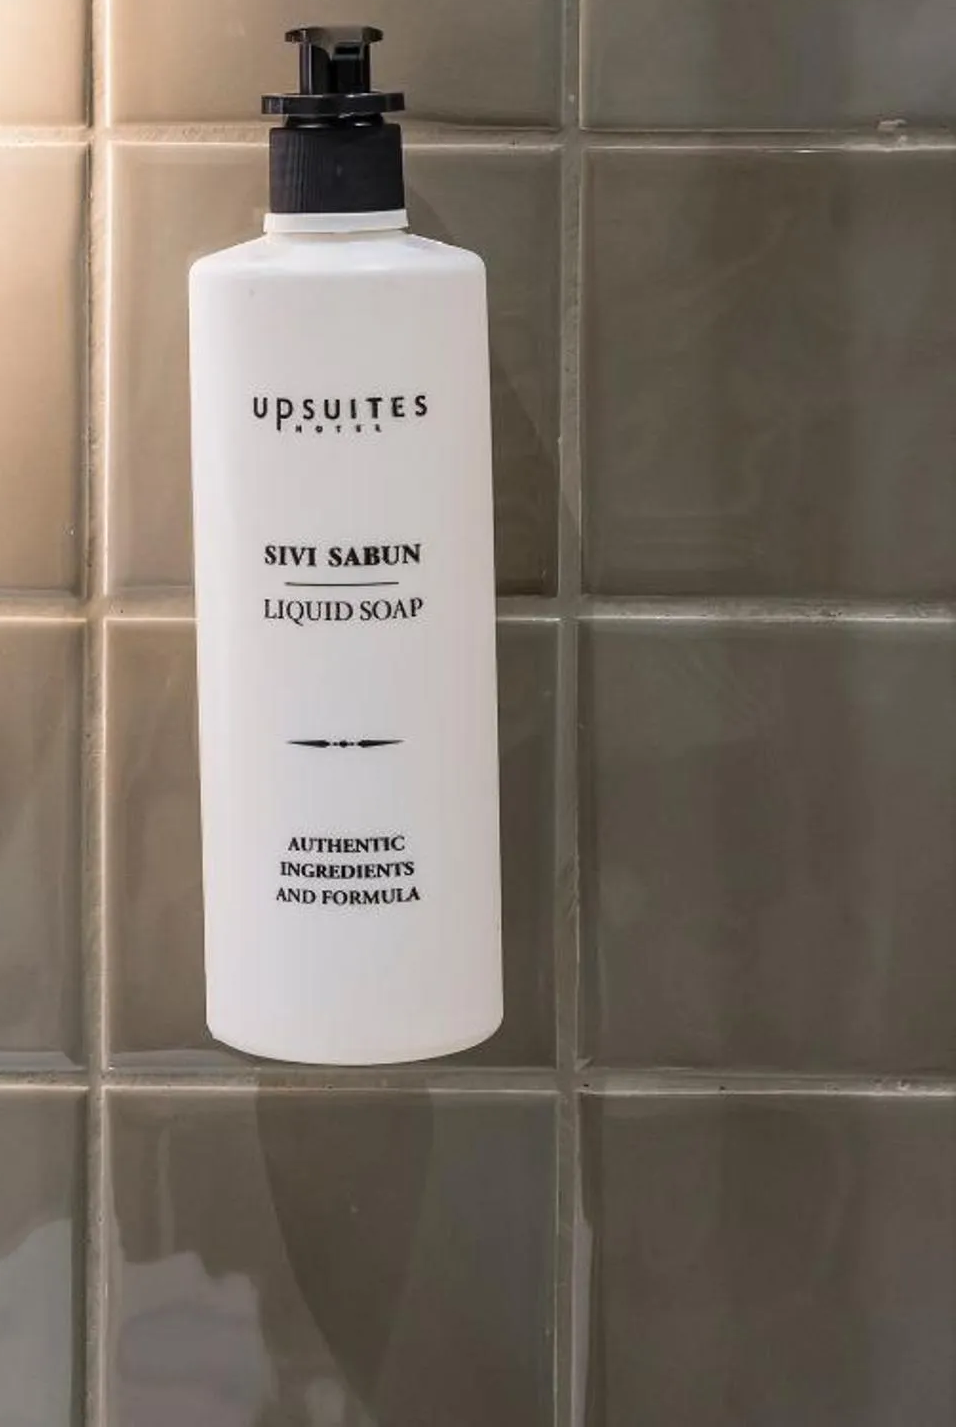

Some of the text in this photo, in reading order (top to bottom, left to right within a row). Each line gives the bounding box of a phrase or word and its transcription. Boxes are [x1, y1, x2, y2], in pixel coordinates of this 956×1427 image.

[294, 423, 382, 434] HOTEL
[264, 543, 422, 568] SIVI SABUN
[264, 597, 424, 627] LIQUID SOAP
[287, 835, 406, 854] AUTHENTIC
[280, 861, 415, 880] INGREDIENTS
[276, 886, 421, 906] AND FORMULA
